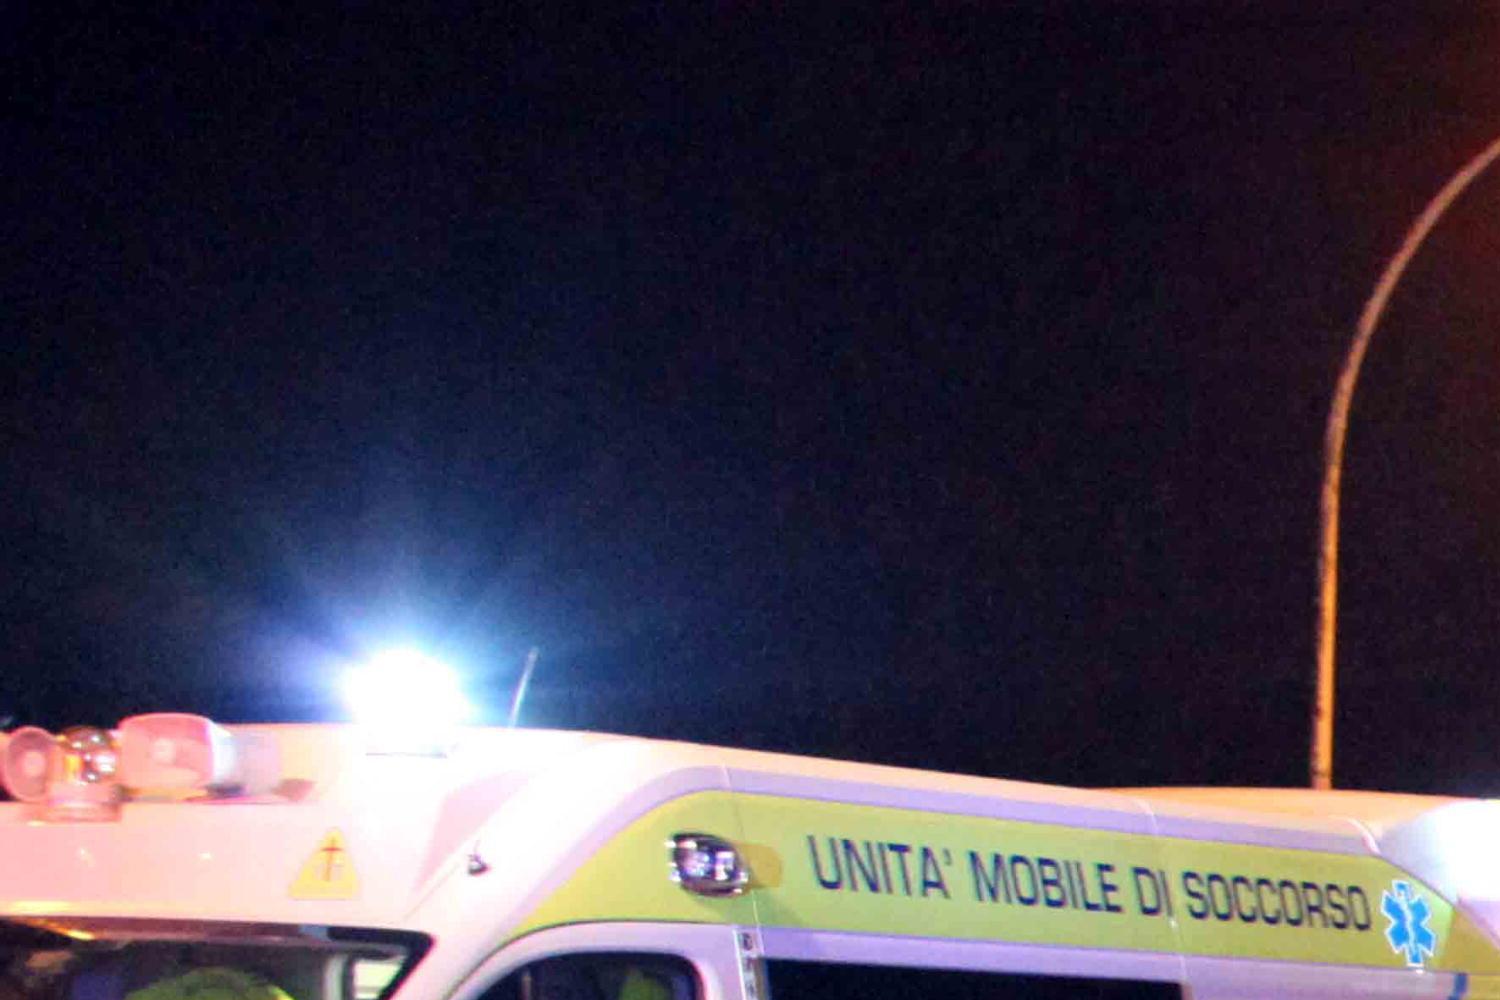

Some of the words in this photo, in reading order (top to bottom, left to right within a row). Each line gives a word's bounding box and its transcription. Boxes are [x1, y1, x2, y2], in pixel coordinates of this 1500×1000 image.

[807, 834, 953, 899] UNITA'
[968, 849, 1123, 914] MOBILE
[1131, 866, 1174, 917] DI
[1181, 870, 1372, 931] SOCCORSO
